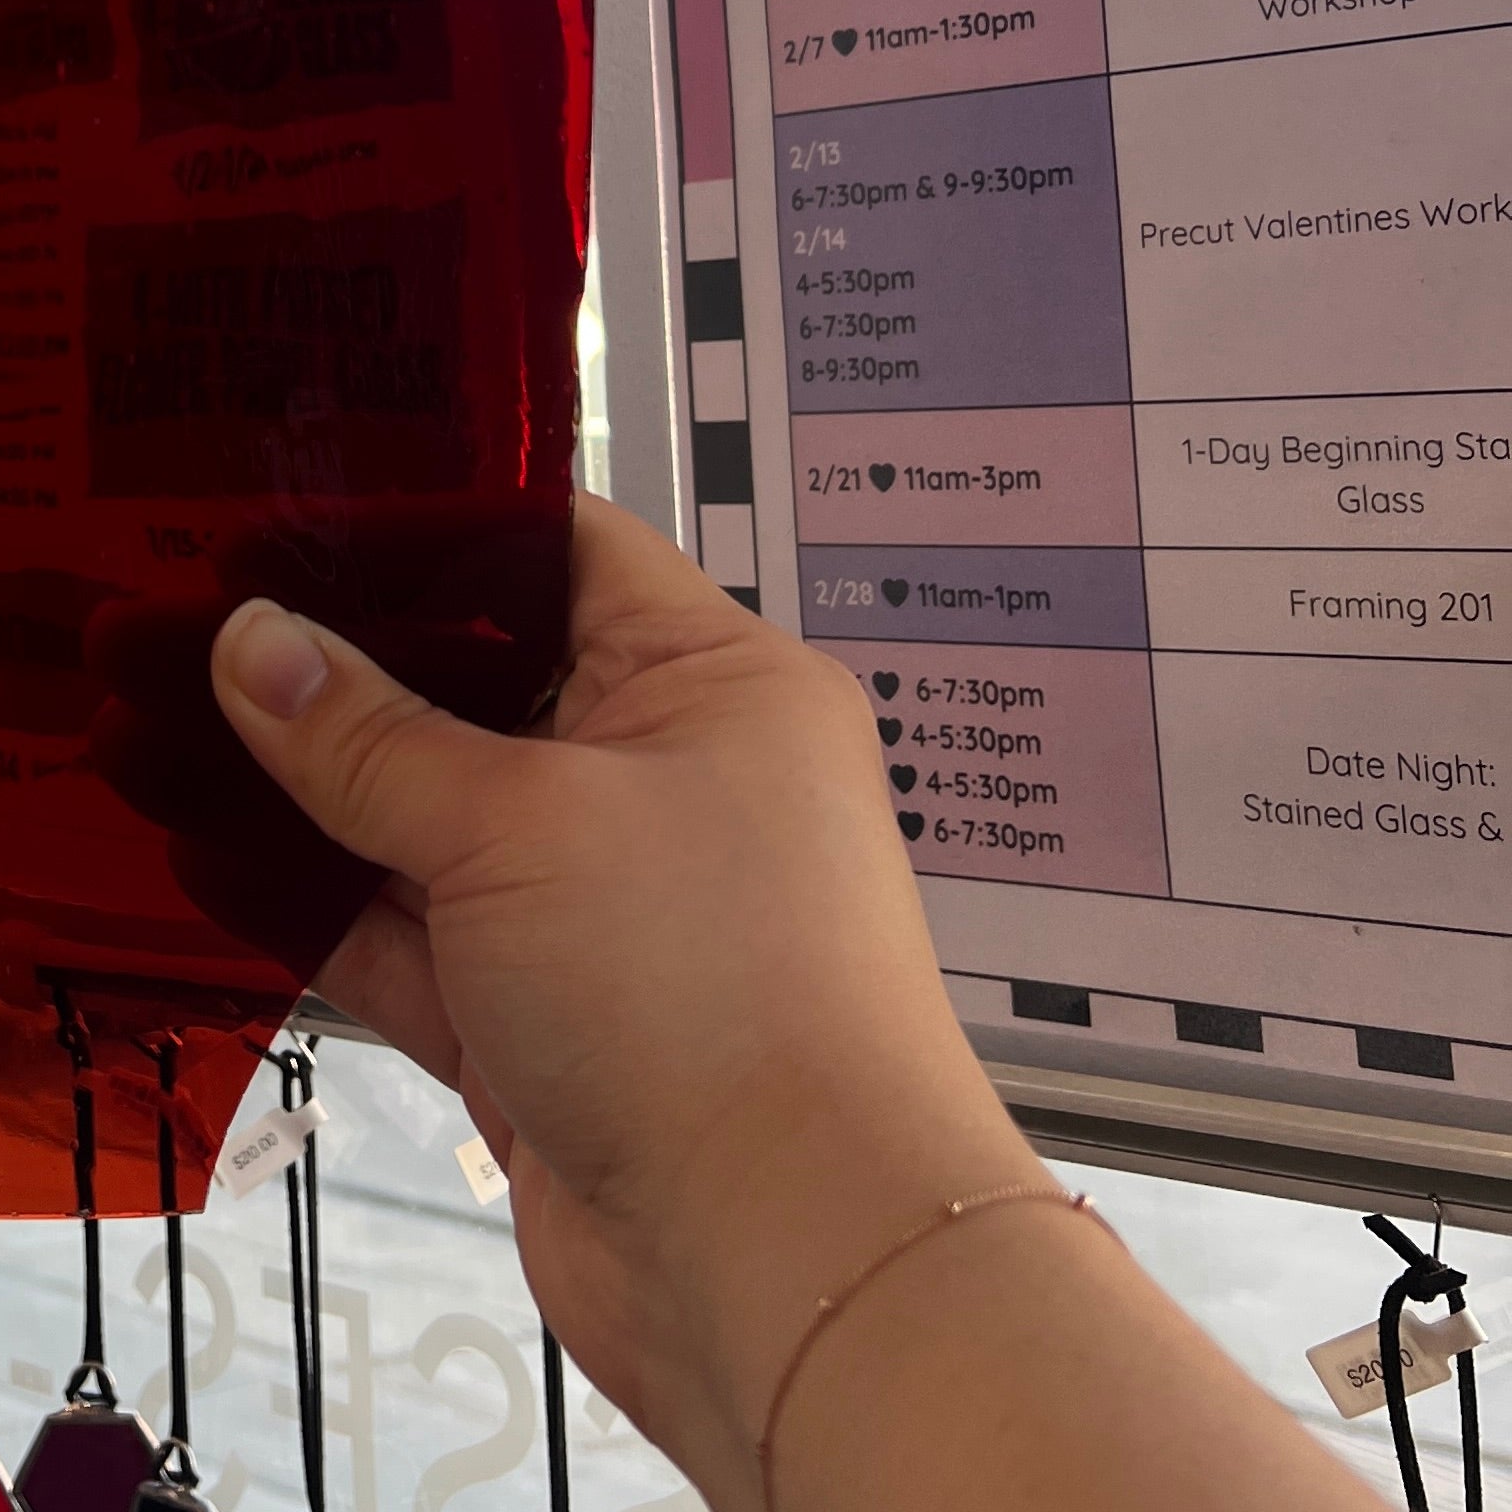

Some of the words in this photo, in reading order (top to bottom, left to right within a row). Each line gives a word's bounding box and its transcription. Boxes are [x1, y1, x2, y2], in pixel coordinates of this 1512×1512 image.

[783, 36, 825, 66] 2/7
[864, 9, 1036, 51] 11am-1:30pm
[789, 141, 841, 172] 2/13
[791, 181, 908, 211] 6-7:30pm
[916, 175, 935, 199] &
[944, 165, 1074, 196] 9-9:30pm
[1141, 218, 1235, 249] Precut
[1243, 208, 1411, 241] Valentines
[1420, 193, 1512, 228] Work
[793, 225, 847, 257] 2/14
[796, 268, 915, 297] 4-5:30pm
[800, 313, 917, 341] 6-7:30pm
[802, 356, 920, 386] 8-9:30pm
[1182, 437, 1270, 471] 1-Day
[1282, 435, 1444, 469] Beginning
[1455, 432, 1511, 461] Sta
[807, 465, 862, 495] 2/21
[903, 465, 1042, 496] 11am-3pm
[1338, 484, 1425, 514] Glass
[815, 578, 875, 608] 2/28
[917, 583, 1052, 616] 11am-1pm
[1290, 589, 1427, 627] Framing
[1439, 592, 1493, 622] 201
[916, 677, 1045, 711] 6-7:30pm
[911, 723, 1042, 759] 4-5:30pm
[1307, 746, 1385, 779] Date
[1397, 752, 1496, 792] Night:
[925, 771, 1058, 807] 4-5:30pm
[933, 817, 1065, 855] 6-7:30pm
[1243, 793, 1364, 830] Stained
[1375, 803, 1467, 839] Glass
[1478, 811, 1504, 843] &
